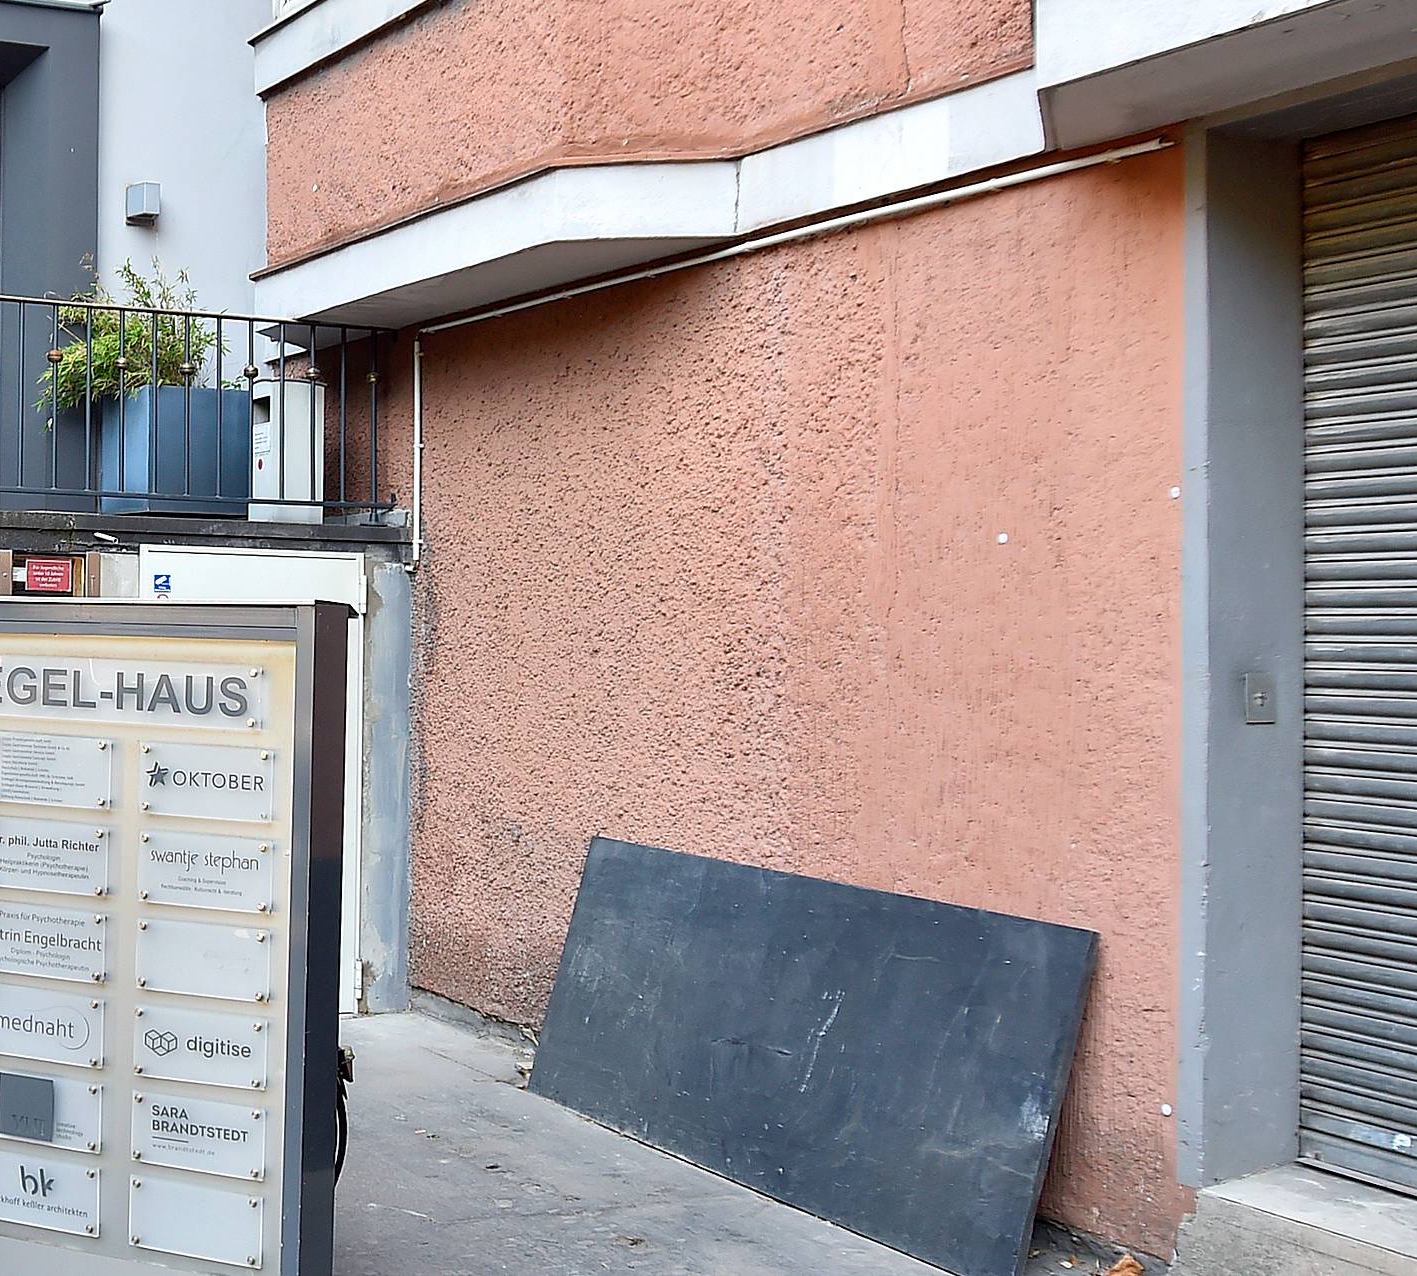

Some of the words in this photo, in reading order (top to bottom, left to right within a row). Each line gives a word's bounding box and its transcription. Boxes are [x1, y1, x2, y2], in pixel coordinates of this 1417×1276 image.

[172, 770, 264, 791] OKTOBER
[8, 835, 30, 847] phil.
[32, 837, 58, 849] Jutta
[61, 839, 100, 852] Richter
[26, 852, 61, 862] Psychologin
[150, 850, 199, 872] swantje
[204, 850, 259, 875] stephan
[40, 861, 89, 872] (Psychotherapie)
[0, 909, 19, 920] Praxis
[20, 911, 30, 920] für
[31, 913, 86, 927] Psychotherapie
[24, 930, 101, 951] Engelbracht
[36, 950, 71, 960] Psychologin
[36, 958, 89, 971] Psychotherapeutin
[187, 1036, 251, 1058] digitise
[152, 1104, 188, 1120] SARA
[152, 1119, 248, 1142] BRANDTSTEDT
[152, 1144, 215, 1156] www.brandtstedt.de
[46, 1204, 88, 1218] architekten
